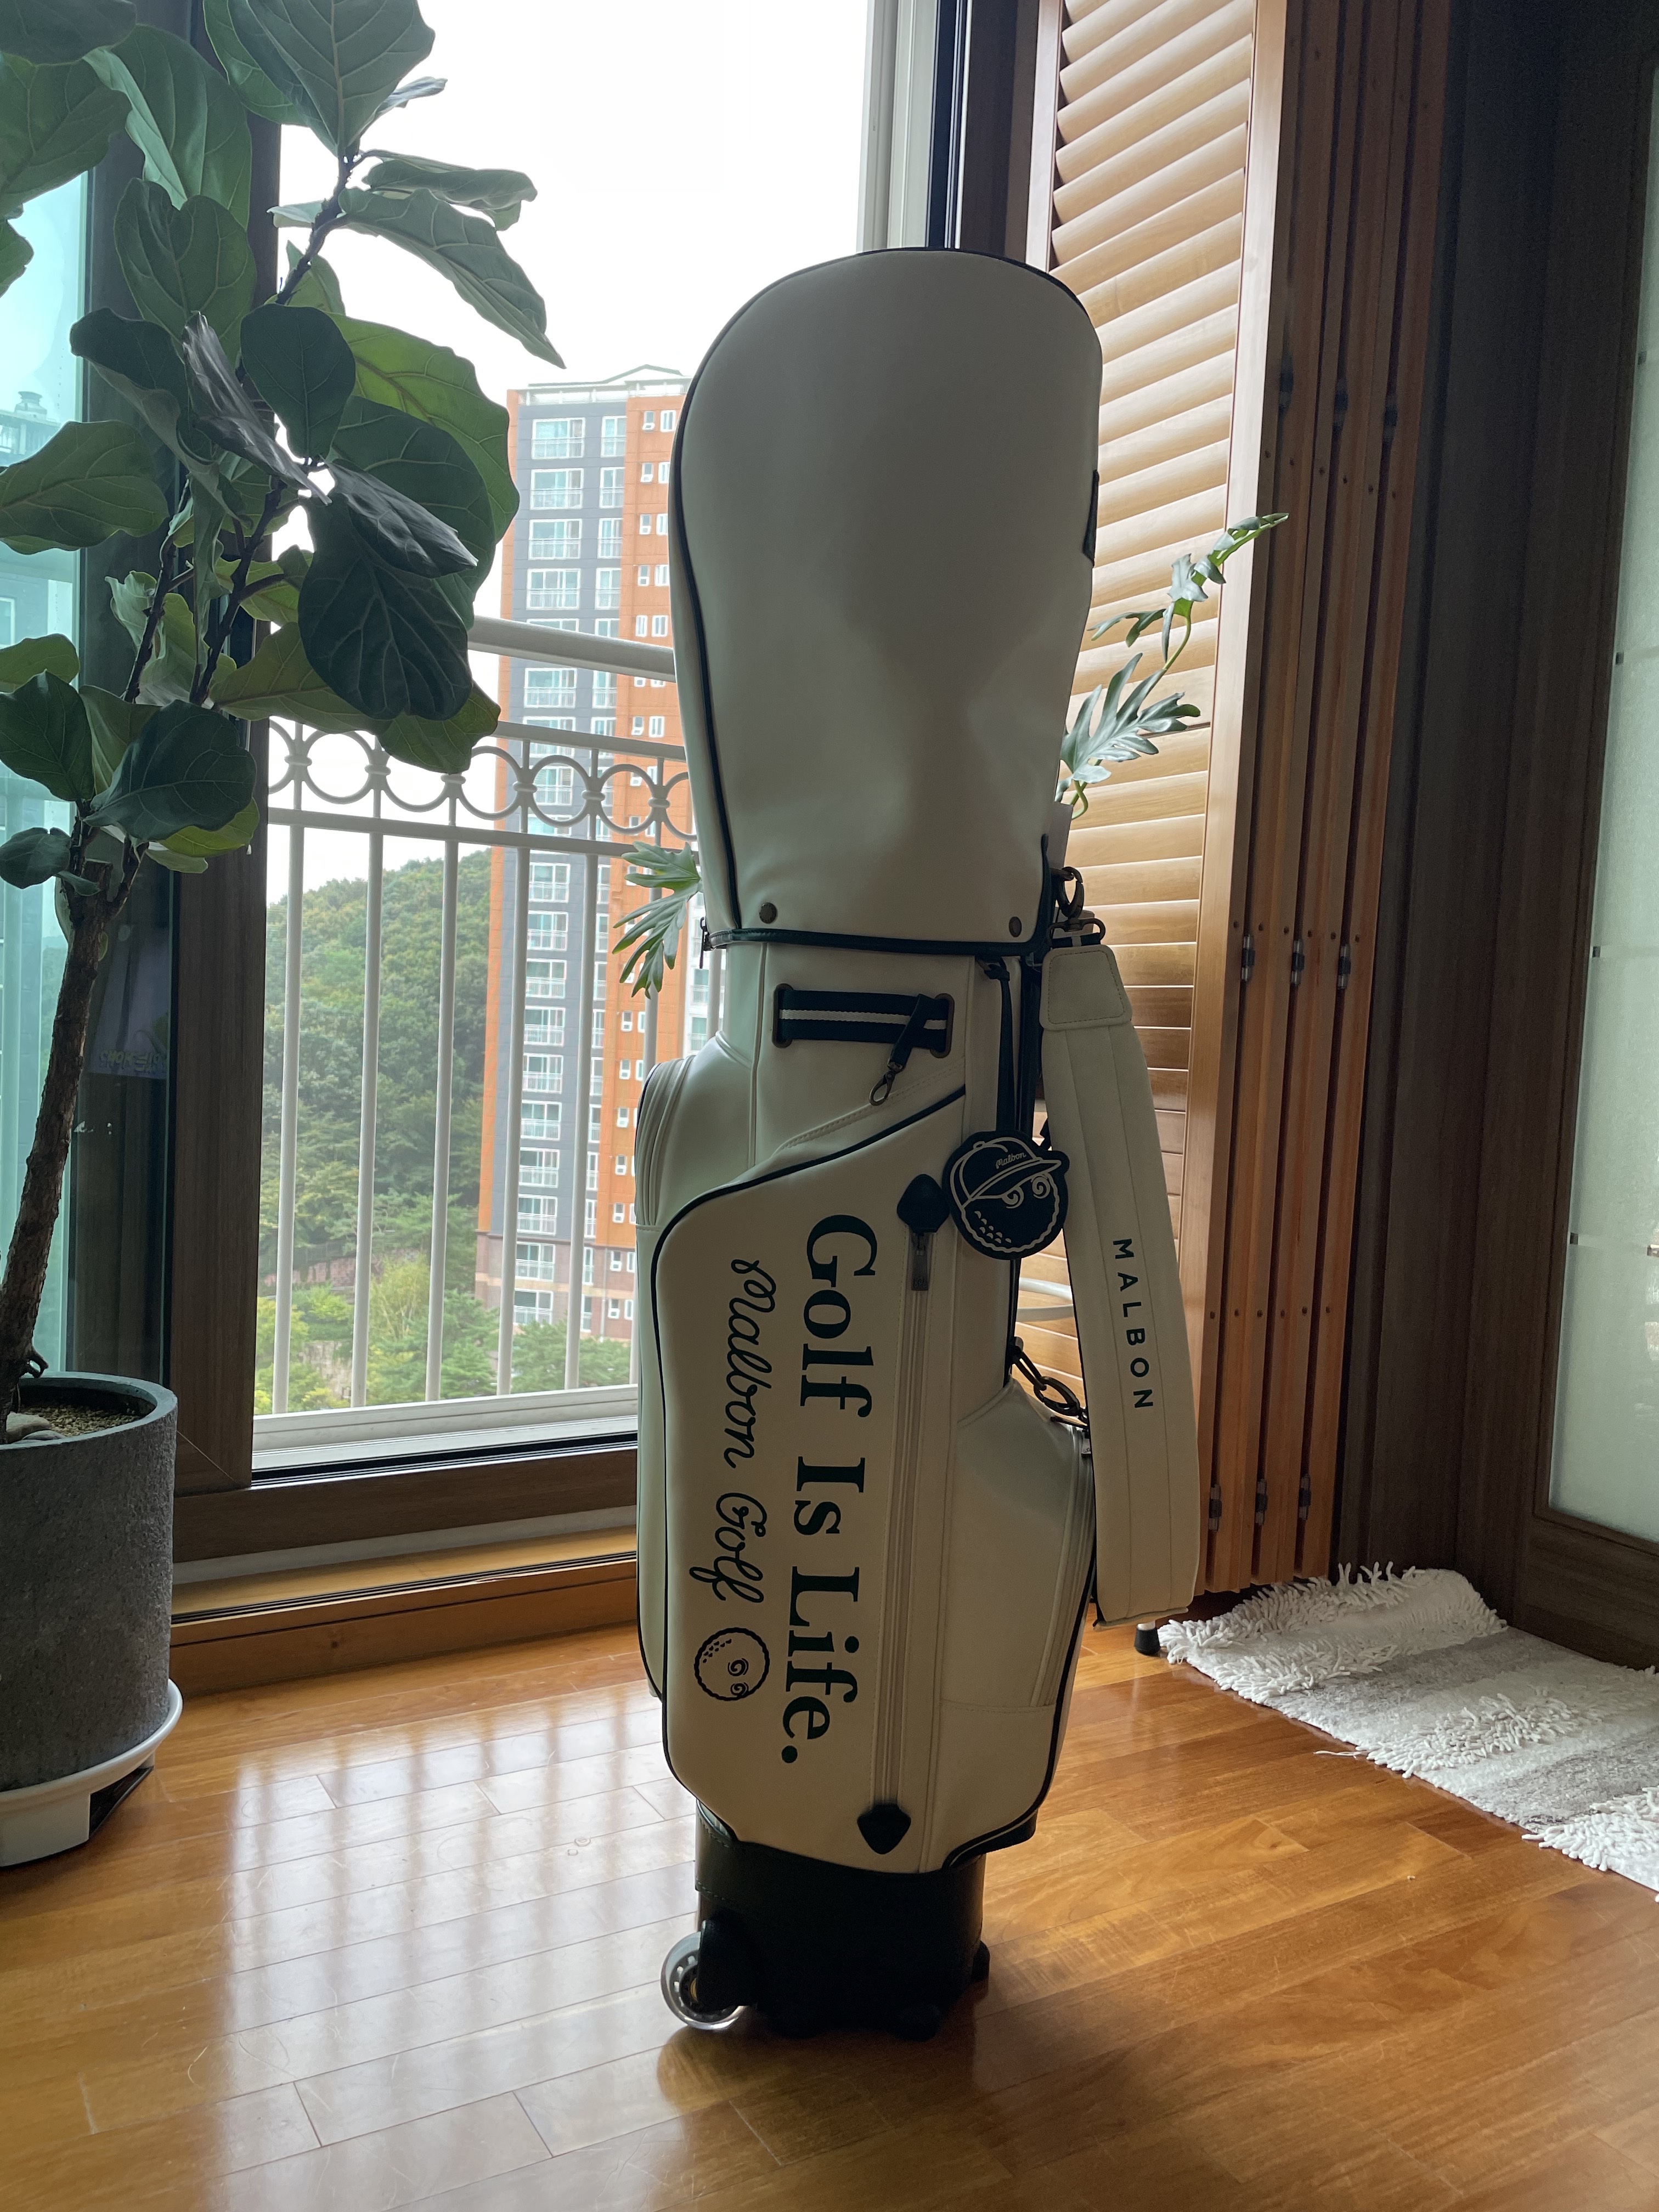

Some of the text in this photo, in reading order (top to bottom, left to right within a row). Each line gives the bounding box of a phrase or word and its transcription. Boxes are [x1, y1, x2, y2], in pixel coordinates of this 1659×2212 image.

[995, 1152, 1027, 1169] Malbon
[689, 1259, 777, 1604] Malbon Golf
[1113, 1238, 1154, 1408] MALBON
[781, 1214, 878, 1764] Golf Is Life.
